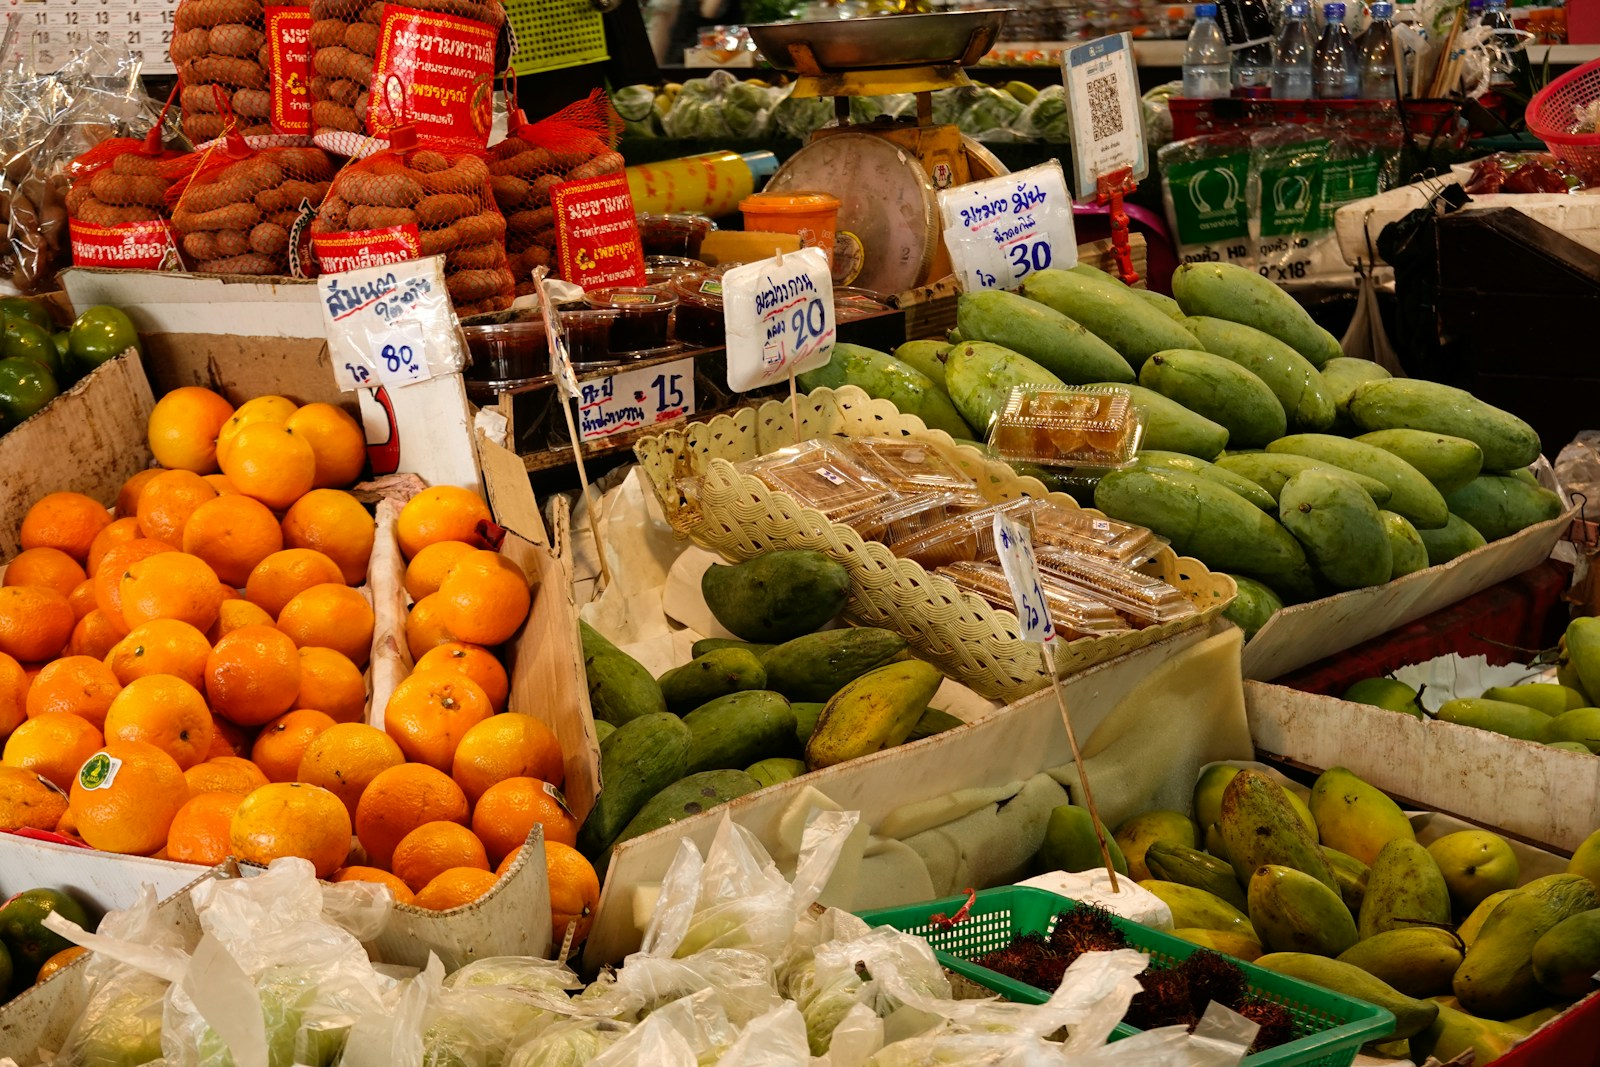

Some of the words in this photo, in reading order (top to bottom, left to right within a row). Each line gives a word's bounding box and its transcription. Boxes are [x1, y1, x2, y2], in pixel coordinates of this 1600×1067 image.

[34, 12, 48, 25] 11
[65, 12, 79, 25] 12
[95, 11, 109, 24] 13
[127, 11, 141, 24] 14
[160, 11, 175, 24] 15
[128, 31, 141, 44] 21
[1011, 183, 1047, 214] มัน
[901, 247, 911, 260] 2
[1009, 241, 1052, 279] 30
[1227, 245, 1247, 259] HD
[976, 269, 996, 287] โล
[767, 316, 786, 340] กล่อง
[791, 298, 825, 350] 20
[345, 363, 370, 383] โล
[381, 344, 413, 373] 80
